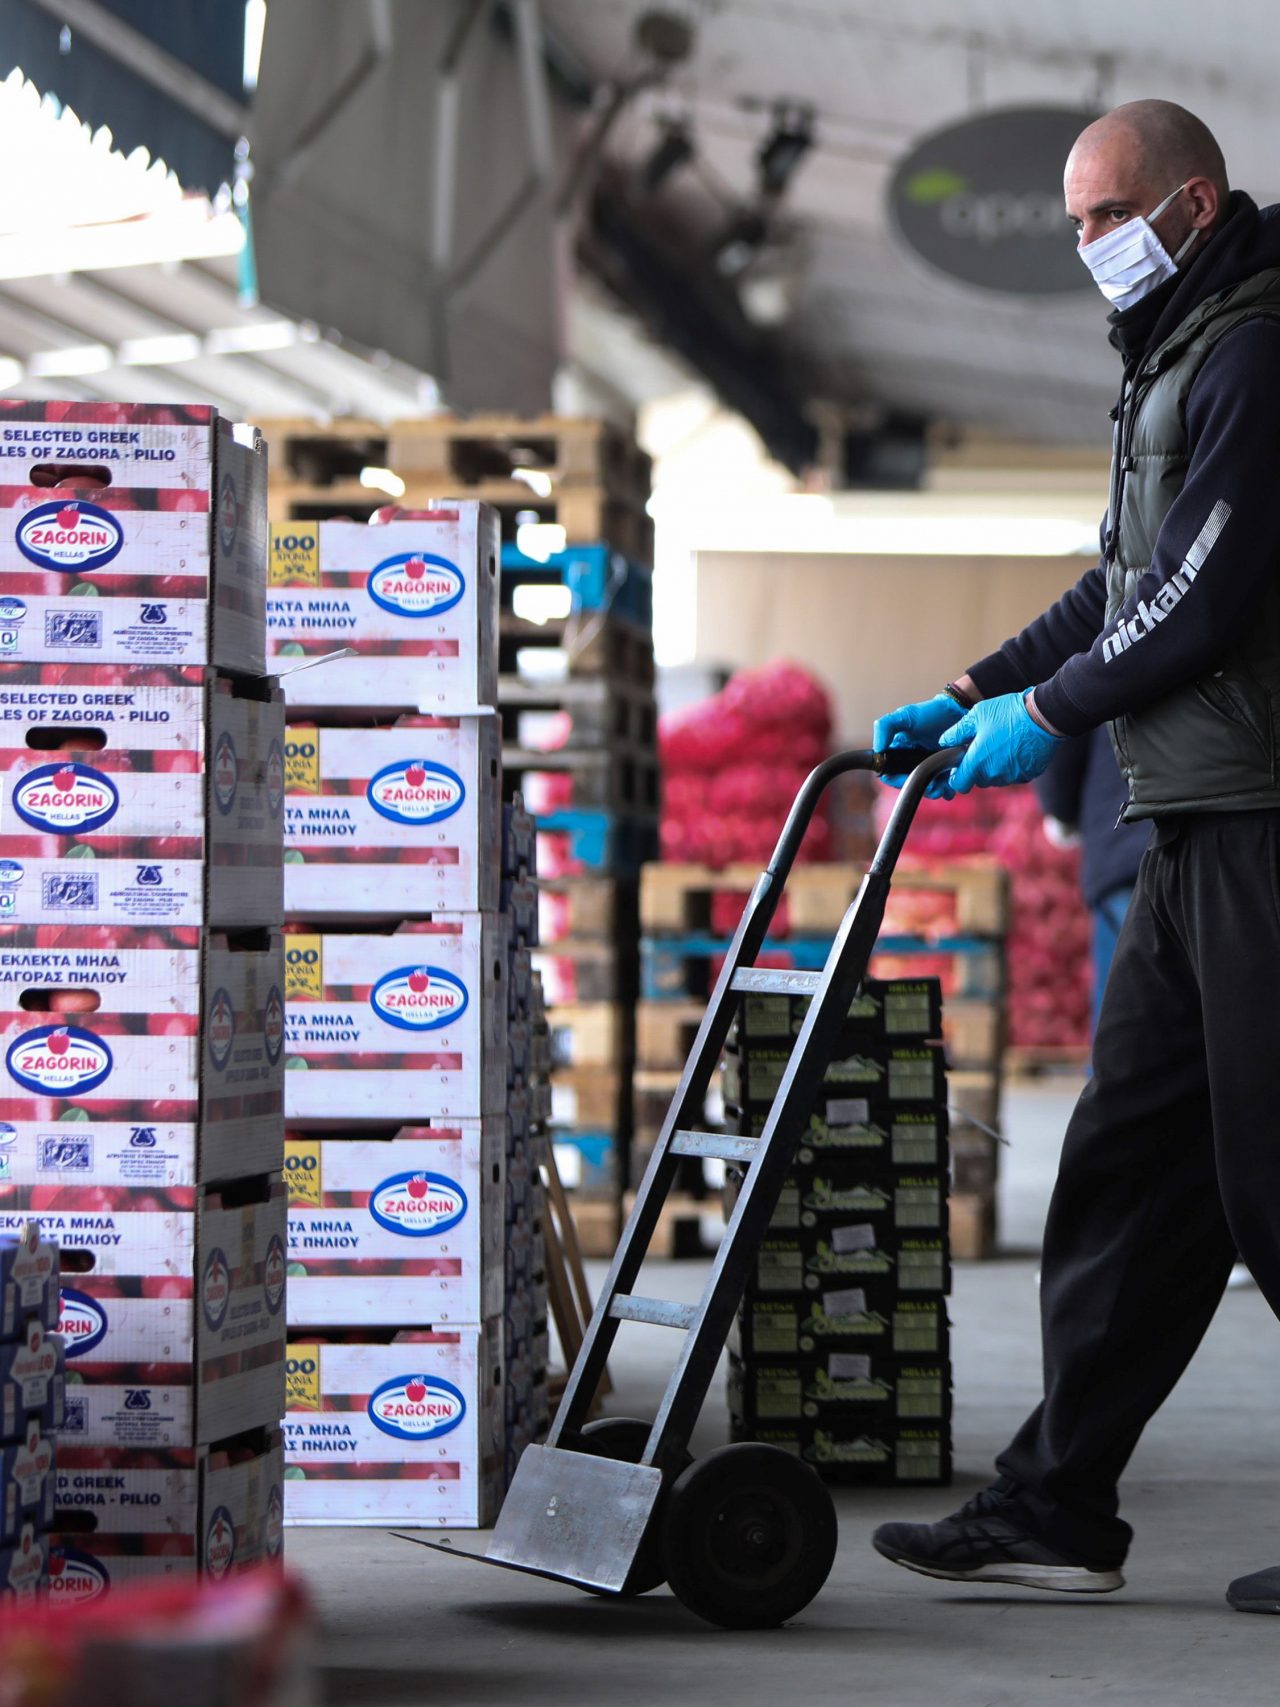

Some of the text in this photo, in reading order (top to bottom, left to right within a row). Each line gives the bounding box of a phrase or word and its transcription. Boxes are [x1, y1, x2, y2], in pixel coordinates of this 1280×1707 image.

[4, 430, 140, 443] SELECTED GREEK
[31, 446, 52, 459] OF
[56, 447, 120, 460] ZAGORA
[134, 449, 176, 461] PILIO
[31, 530, 107, 545] ZAGORIN
[274, 535, 315, 551] 100
[53, 550, 84, 558] HELLAS
[382, 579, 451, 594] ZAGORIN
[266, 601, 350, 612] ΕΚΤΑ ΜΗΛΑ
[266, 616, 357, 629] ΡΑΣ ΠΗΛΙΟΥ
[0, 693, 135, 706] SELECTED GREEK
[27, 709, 48, 721] OF
[52, 710, 115, 722] ZAGORA
[129, 711, 170, 723] PILIO
[27, 793, 103, 807] ZAGORIN
[382, 787, 451, 801] ZAGORIN
[50, 813, 80, 821] HELLAS
[308, 808, 350, 820] ΜΗΛΑ
[301, 824, 357, 836] ΠΗΛΙΟΥ
[1, 954, 120, 967] ΕΚΛΕΚΤΑ ΜΗΛΑ
[68, 972, 127, 984] ΠΗΛΙΟΥ
[385, 993, 454, 1007] ZAGORIN
[312, 1014, 354, 1026] ΜΗΛΑ
[305, 1030, 360, 1042] ΠΗΛΙΟΥ
[22, 1057, 97, 1071] ZAGORIN
[44, 1075, 74, 1083] HELLAS
[384, 1199, 453, 1213] ZAGORIN
[70, 1218, 115, 1229] ΜΗΛΑ
[310, 1221, 353, 1233] ΜΗΛΑ
[63, 1234, 122, 1245] ΠΗΛΙΟΥ
[303, 1237, 359, 1249] ΠΗΛΙΟΥ
[383, 1404, 452, 1417] ZAGORIN
[309, 1424, 351, 1436] ΜΗΛΑ
[302, 1440, 358, 1452] ΠΗΛΙΟΥ
[74, 1477, 125, 1489] GREEK
[120, 1493, 161, 1505] PILIO
